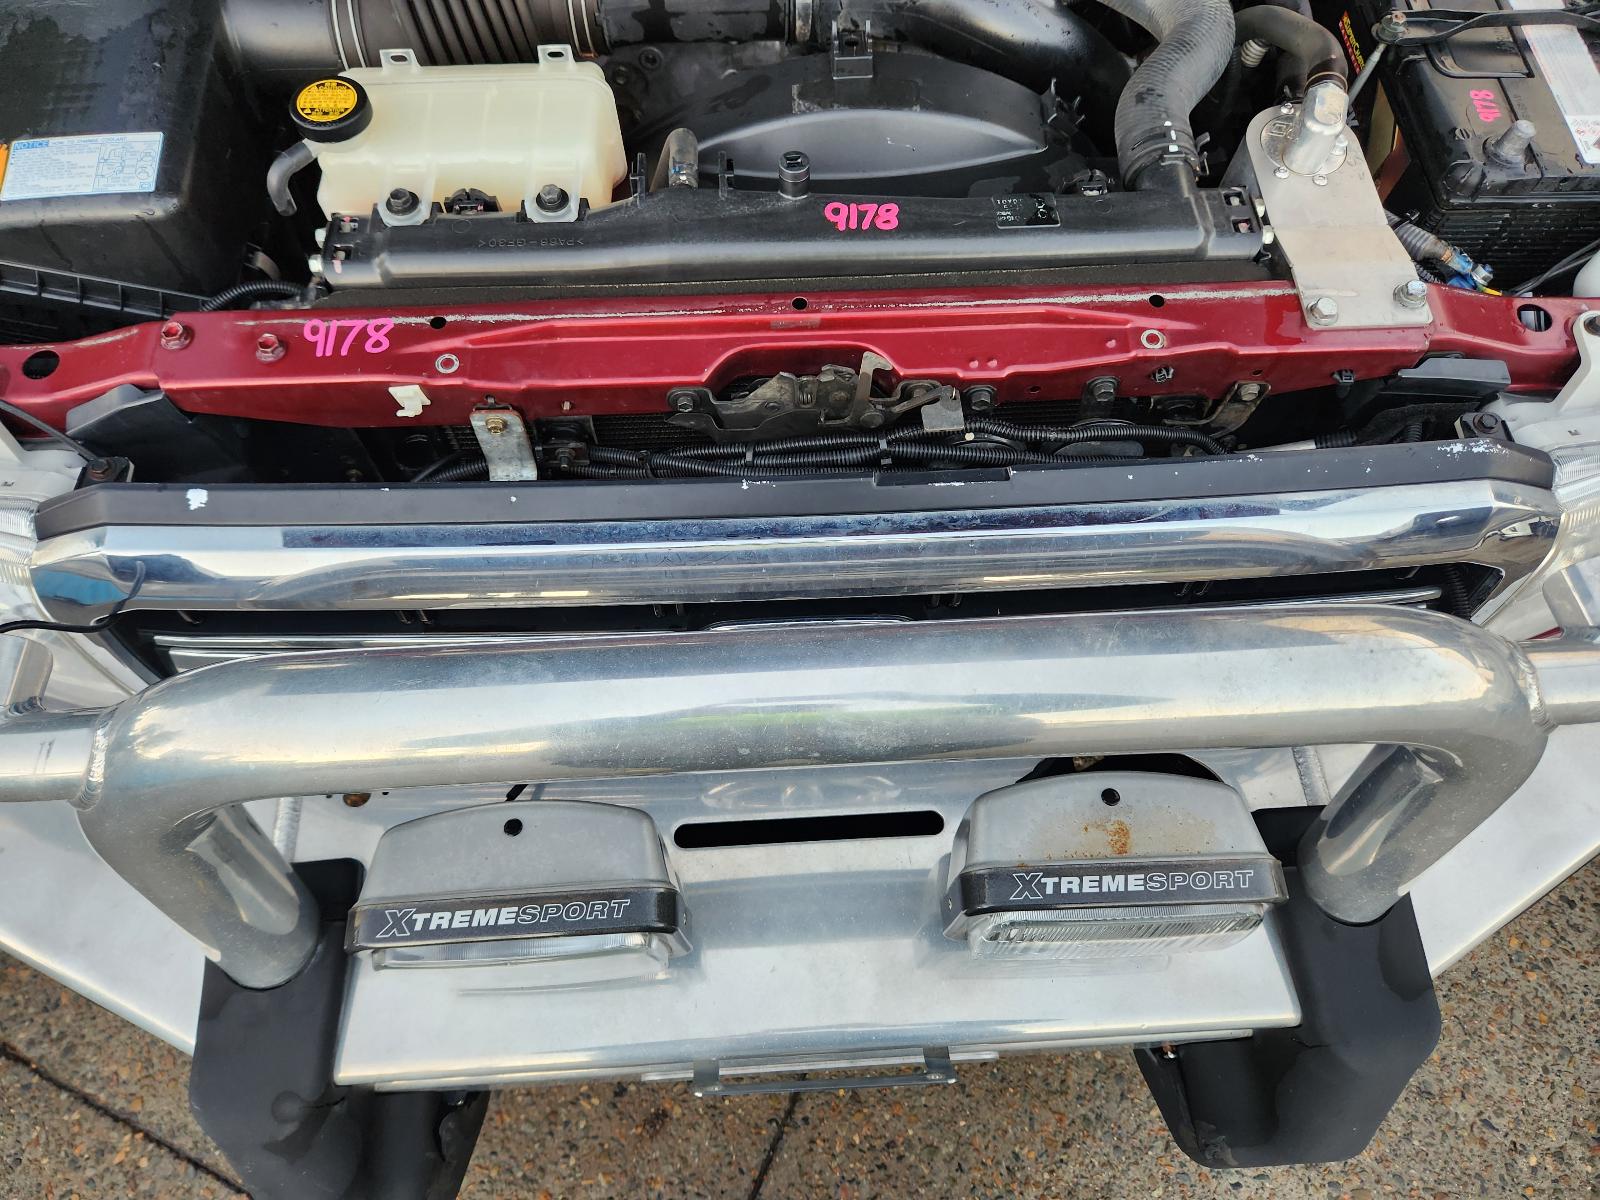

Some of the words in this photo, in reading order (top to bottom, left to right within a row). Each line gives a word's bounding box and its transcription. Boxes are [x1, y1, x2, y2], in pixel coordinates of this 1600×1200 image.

[1470, 89, 1501, 122] 9178
[13, 140, 49, 150] NOTICE
[824, 202, 899, 231] 9178
[303, 317, 395, 357] 9178
[1009, 870, 1254, 900] XTREMESPORT
[376, 898, 631, 938] XTREMESPORT
